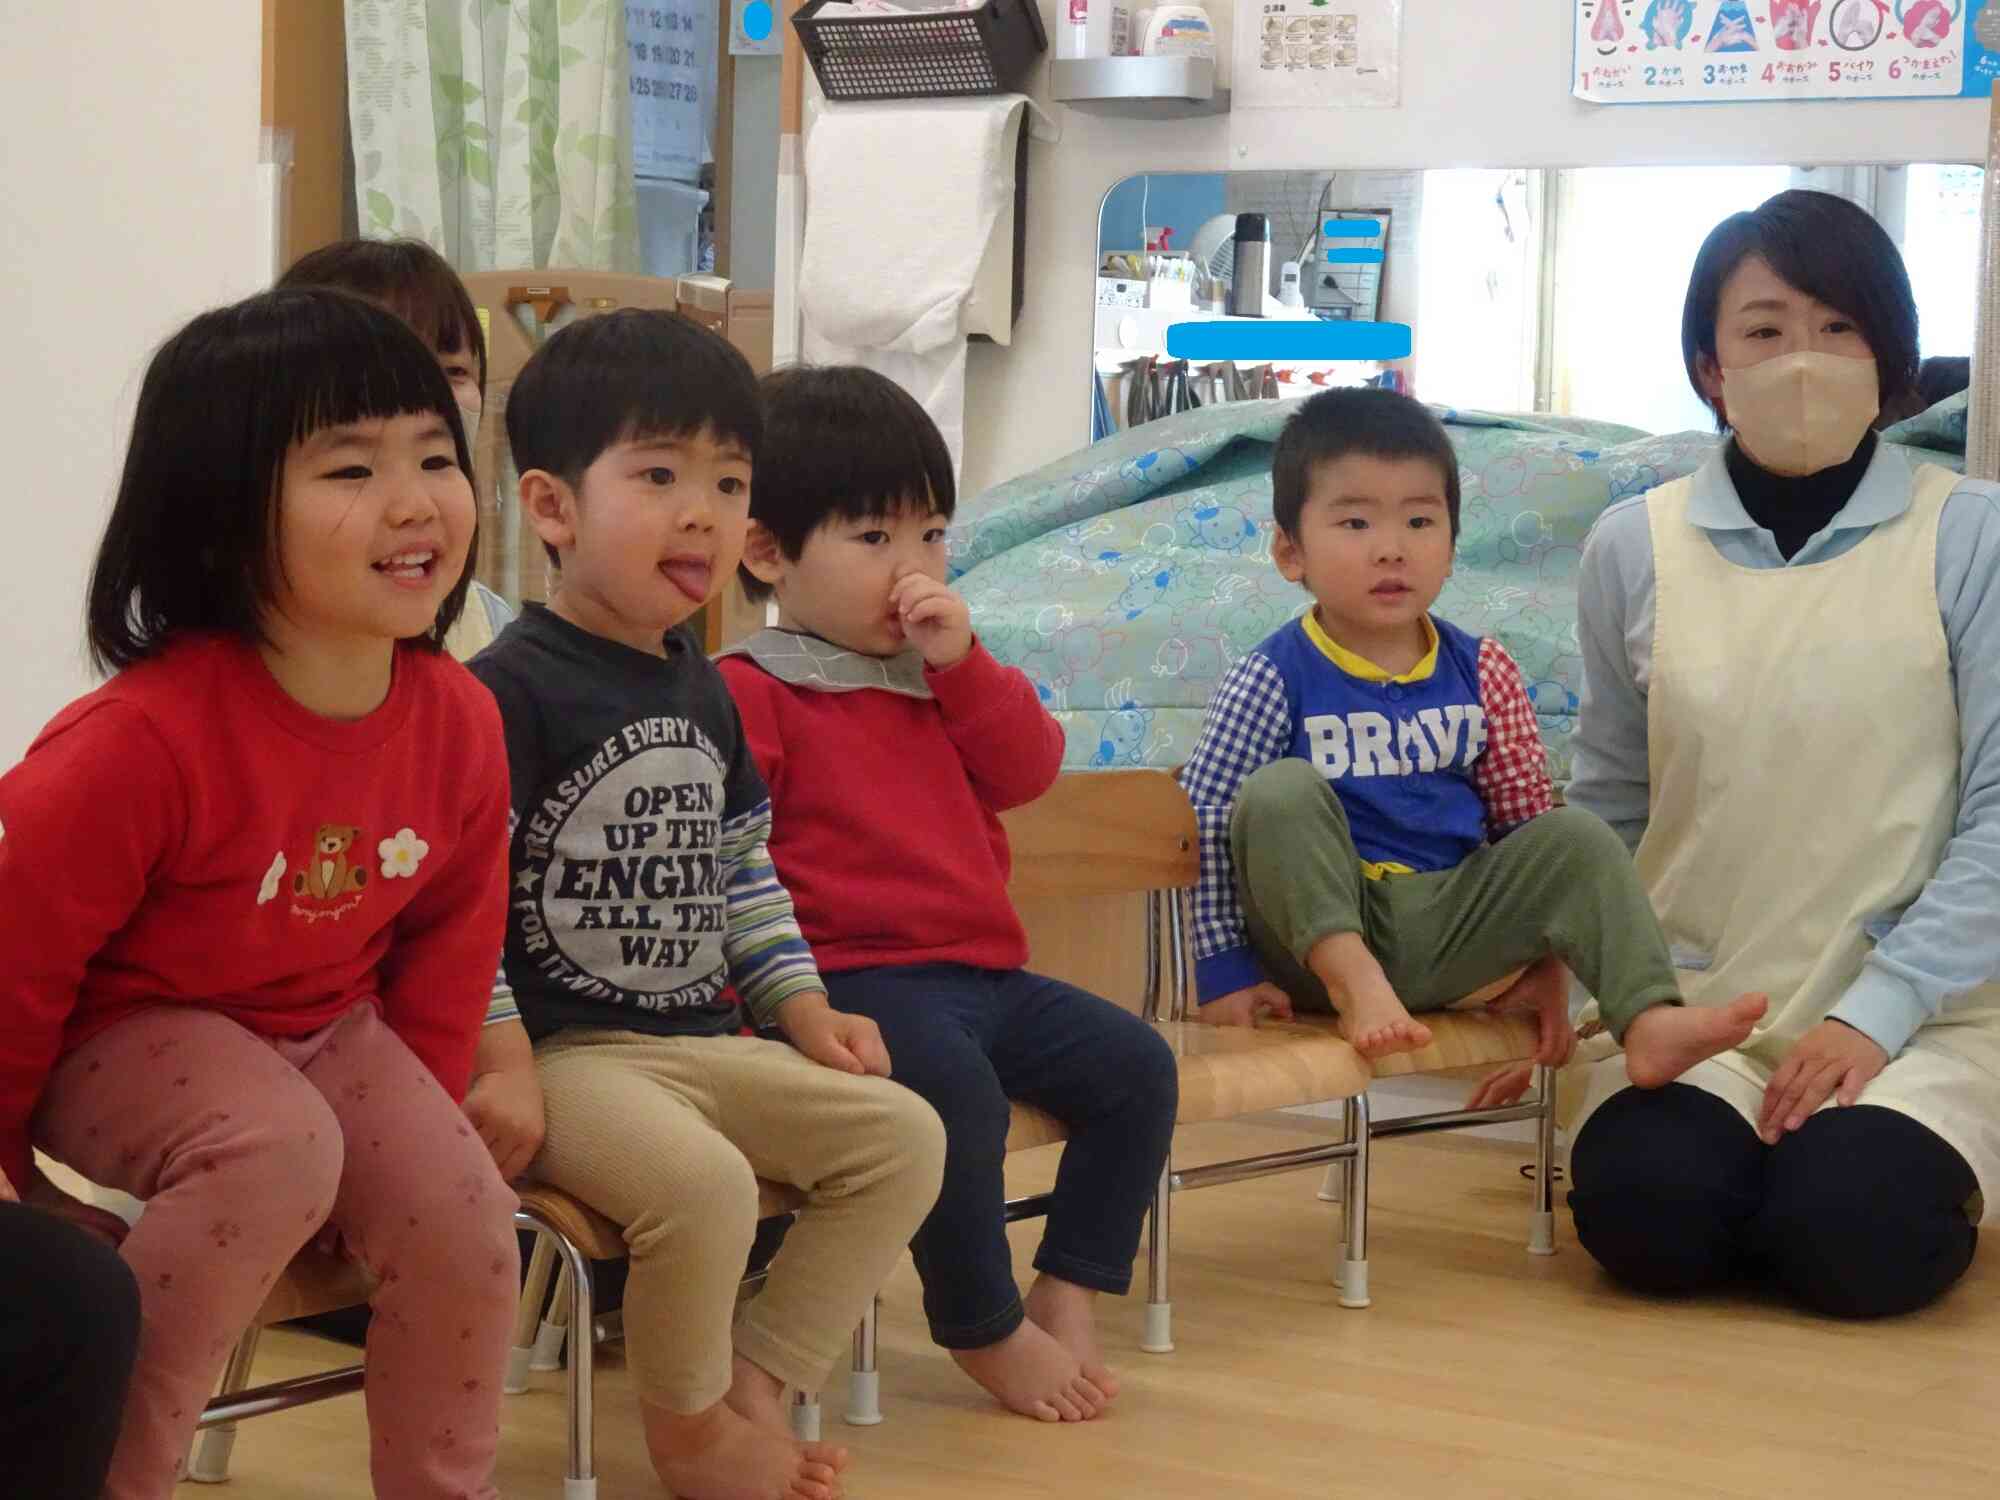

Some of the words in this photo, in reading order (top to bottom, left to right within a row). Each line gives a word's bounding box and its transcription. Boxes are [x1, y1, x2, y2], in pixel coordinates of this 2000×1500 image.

[1643, 66, 1657, 86] 2
[1703, 64, 1716, 85] 3
[1761, 62, 1776, 83] 4
[1828, 61, 1841, 82] 5
[1843, 60, 1875, 72] バイク
[1888, 60, 1902, 79] 6
[636, 76, 650, 96] 25
[1582, 71, 1590, 91] 1
[622, 717, 690, 751] EVERY
[623, 782, 714, 818] OPEN
[603, 822, 658, 851] UP
[574, 904, 661, 930] ALL
[513, 900, 550, 954] FOR
[538, 953, 576, 979] IT
[619, 935, 700, 968] WAY
